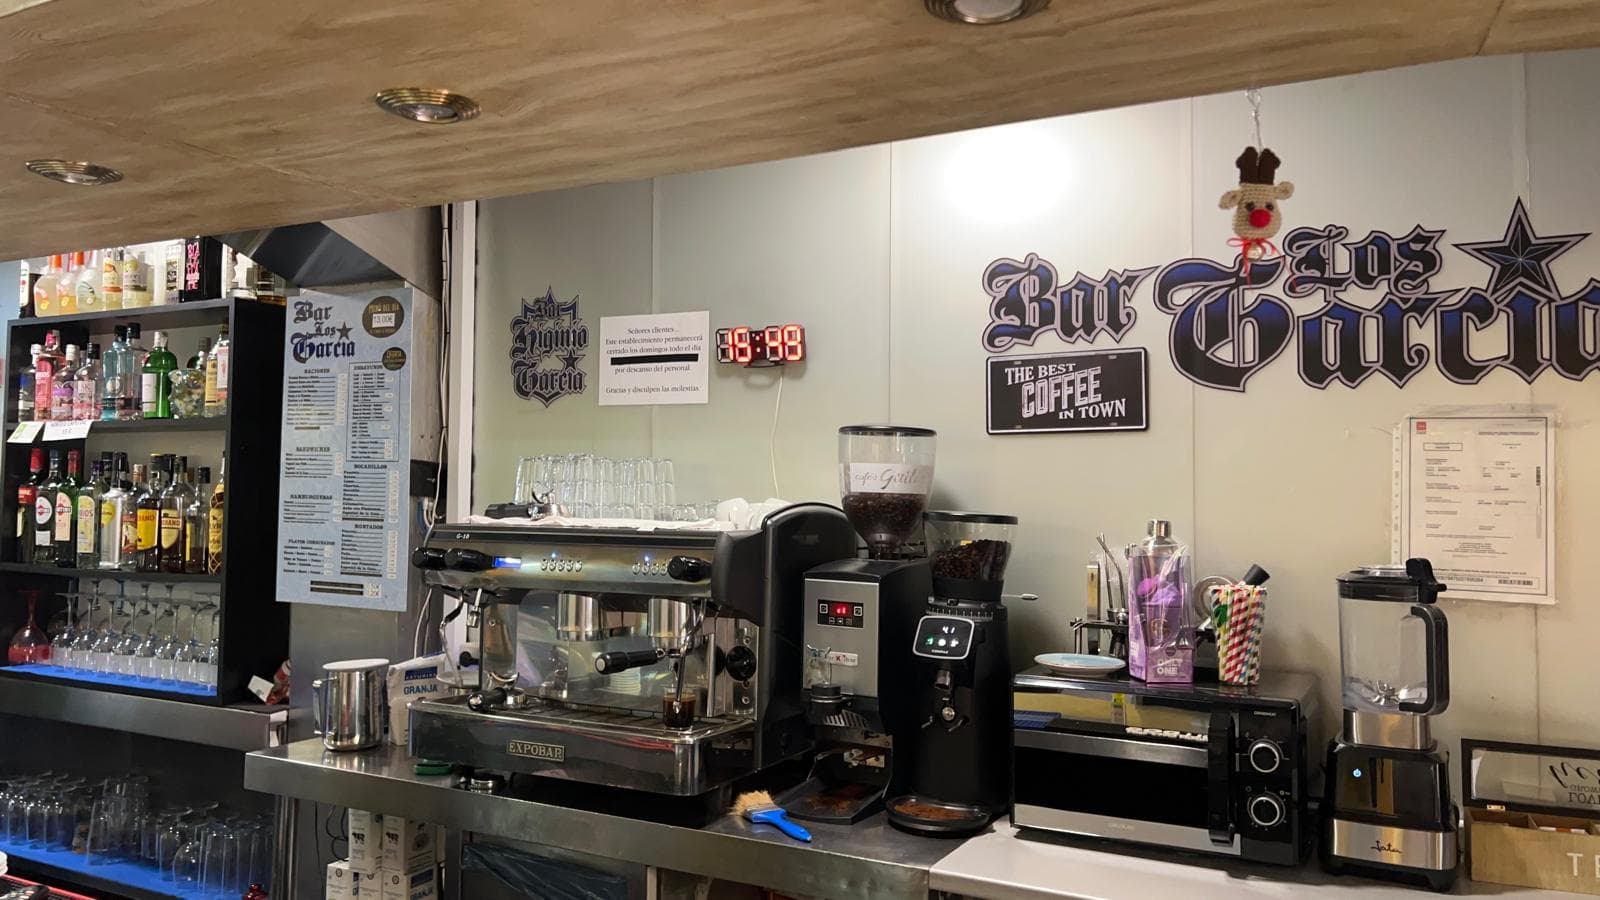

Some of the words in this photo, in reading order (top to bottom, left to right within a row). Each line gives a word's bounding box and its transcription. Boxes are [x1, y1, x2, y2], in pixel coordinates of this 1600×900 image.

[1282, 224, 1446, 297] Los
[982, 253, 1162, 352] Bar
[293, 300, 334, 324] Bar
[313, 321, 337, 338] Los
[627, 327, 651, 335] Señores
[618, 336, 664, 345] establecimiento
[718, 324, 804, 363] 16:48
[606, 347, 629, 355] cerrado
[640, 345, 668, 353] domingos
[669, 344, 684, 352] todo
[614, 367, 625, 375] por
[1005, 366, 1034, 385] THE
[1038, 363, 1076, 379] BEST
[605, 386, 627, 394] Gracias
[632, 385, 660, 394] disculpen
[661, 384, 670, 393] las
[1021, 366, 1102, 418] COFFEE
[1058, 409, 1074, 419] IN
[1078, 399, 1126, 419] TOWN
[1156, 666, 1178, 675] ONE
[403, 683, 438, 695] GRANJA
[509, 742, 562, 759] EXPOBAR
